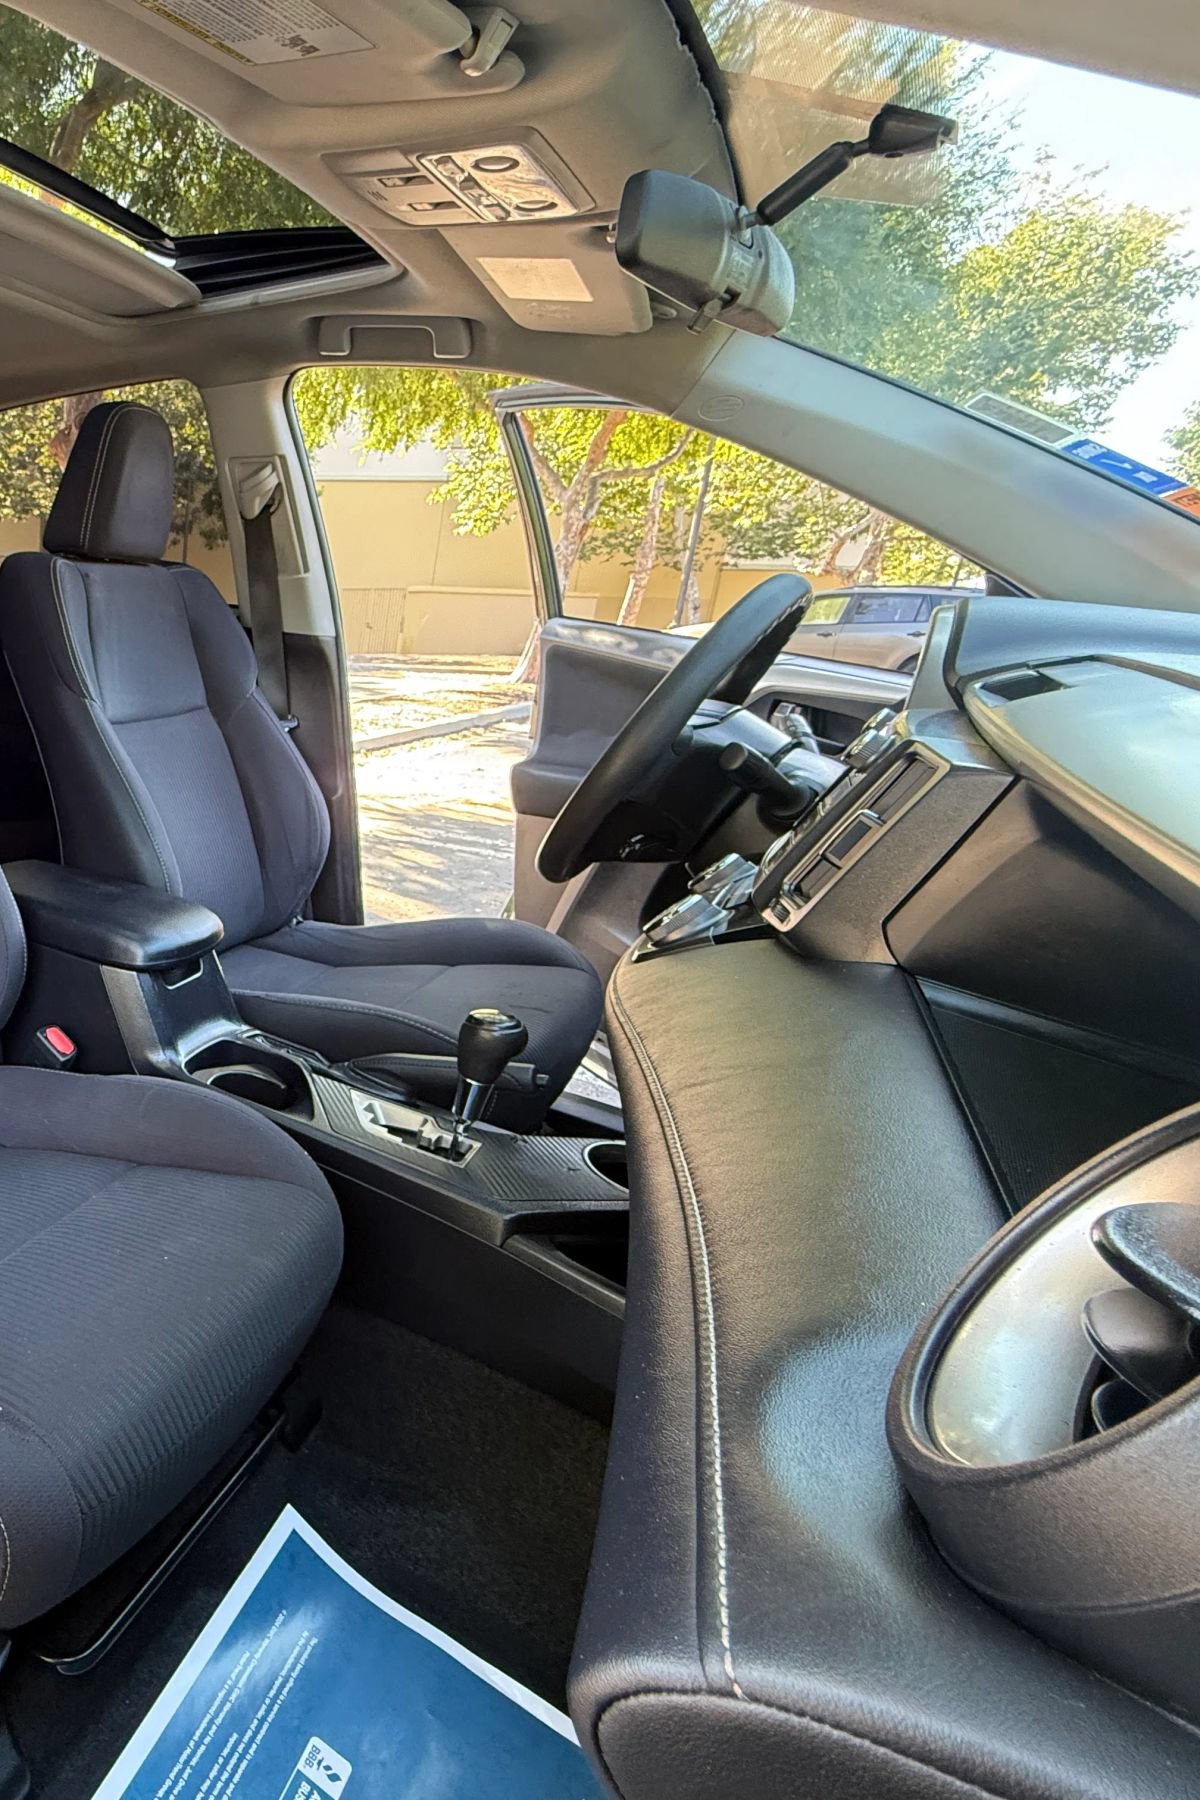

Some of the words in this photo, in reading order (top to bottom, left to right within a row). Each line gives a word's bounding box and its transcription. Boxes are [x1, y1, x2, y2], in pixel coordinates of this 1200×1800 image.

[297, 1644, 313, 1665] product
[289, 1662, 303, 1679] being
[280, 1676, 295, 1696] offered
[207, 1687, 228, 1716] registered
[213, 1700, 232, 1726] Warranty
[265, 1702, 281, 1723] service
[191, 1713, 212, 1741] trademark
[207, 1723, 219, 1737] and
[248, 1718, 260, 1731] and
[253, 1721, 270, 1744] contract
[240, 1728, 253, 1743] does
[235, 1741, 245, 1753] not
[247, 1742, 258, 1755] and
[224, 1751, 241, 1773] extend
[302, 1744, 322, 1769] BBB
[180, 1765, 193, 1780] Just
[206, 1762, 221, 1780] seller
[230, 1758, 249, 1784] separate
[171, 1777, 186, 1796] Drive
[198, 1777, 212, 1792] may
[210, 1780, 223, 1796] term
[224, 1781, 236, 1796] and
